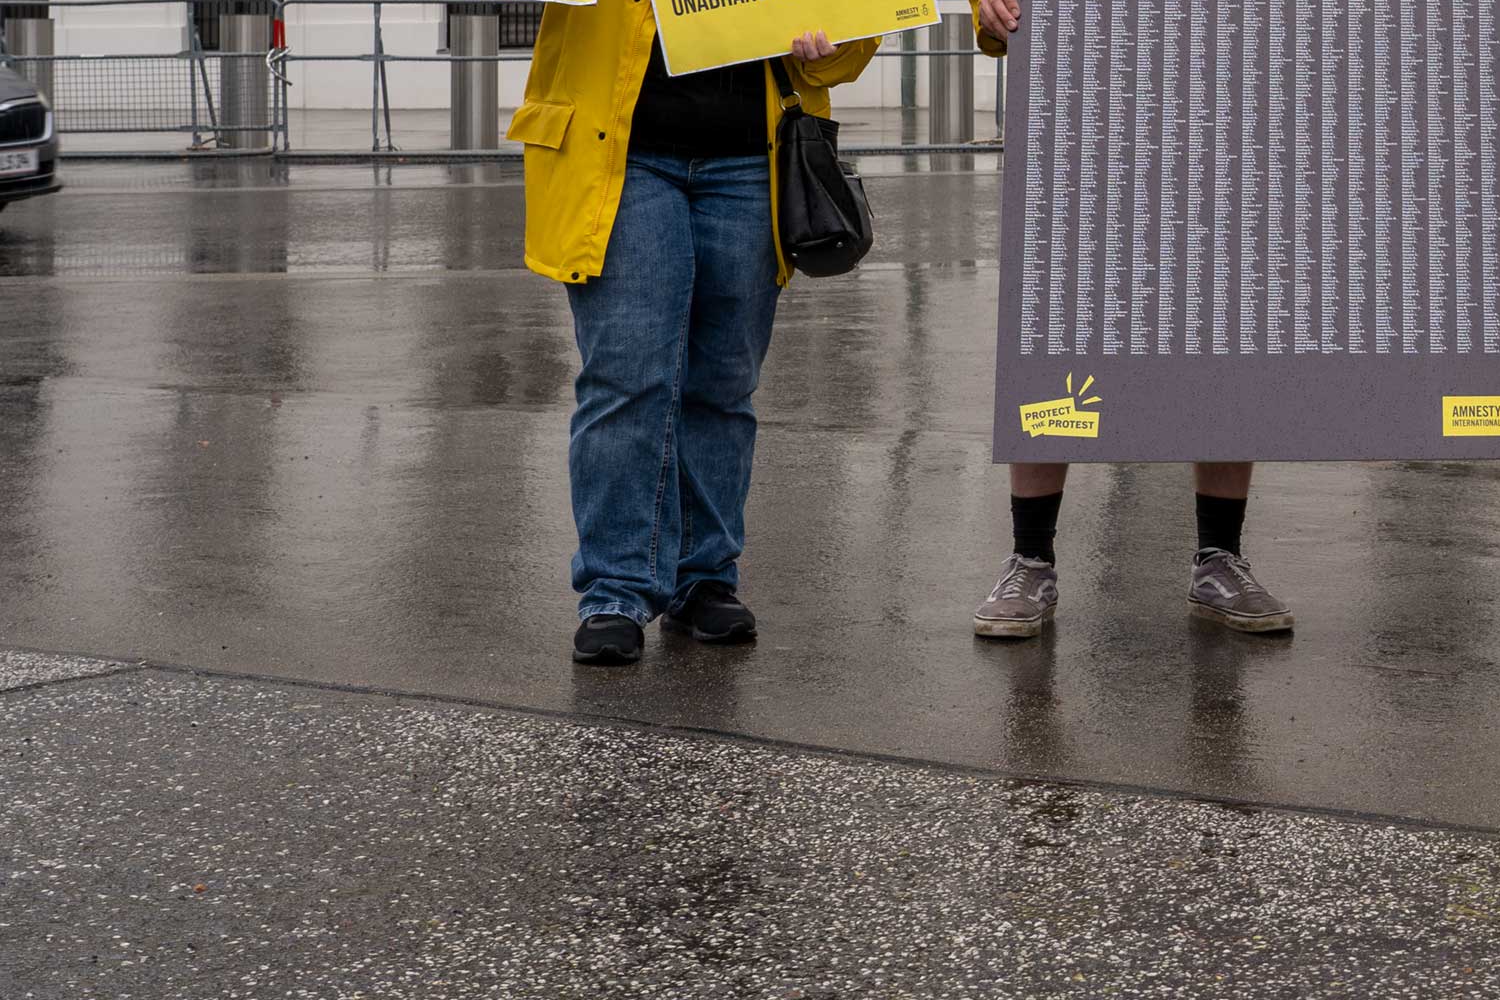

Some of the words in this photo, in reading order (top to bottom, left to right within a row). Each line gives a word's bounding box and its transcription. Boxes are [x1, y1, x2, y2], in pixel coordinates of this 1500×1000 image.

[895, 7, 919, 16] AMNESTY
[1025, 406, 1071, 421] PROTECT
[1452, 405, 1500, 417] AMNESTY
[1032, 421, 1045, 430] THE
[1048, 419, 1095, 429] PROTEST
[1452, 419, 1500, 427] INTERNATIONAL
